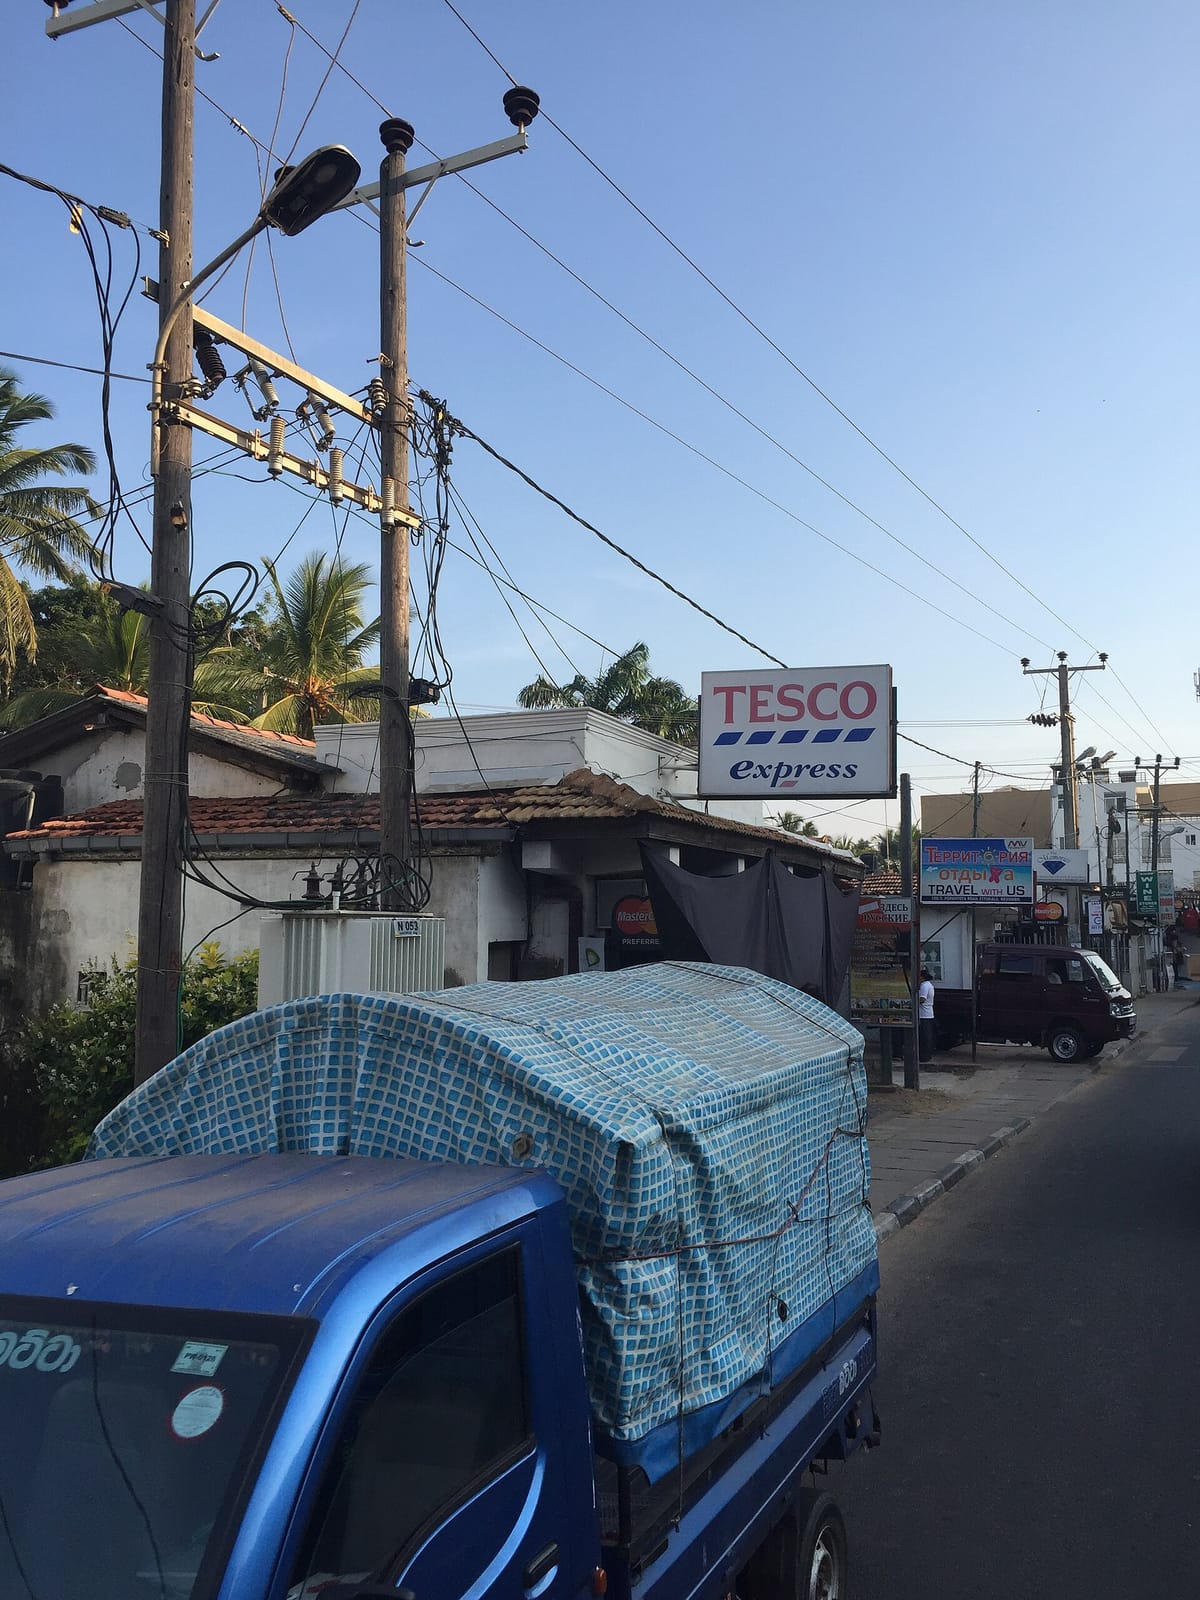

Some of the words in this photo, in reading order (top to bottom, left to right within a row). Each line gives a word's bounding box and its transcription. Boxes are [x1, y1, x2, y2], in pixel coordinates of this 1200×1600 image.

[713, 680, 877, 724] TESCO
[729, 760, 858, 788] express
[928, 884, 978, 896] TRAVEL
[981, 888, 1003, 896] WITH
[1006, 885, 1025, 896] US
[1141, 876, 1154, 901] WINE
[880, 903, 908, 912] ЗДЕСЬ
[617, 911, 656, 921] MasterC
[397, 921, 404, 931] N
[405, 920, 418, 931] 053
